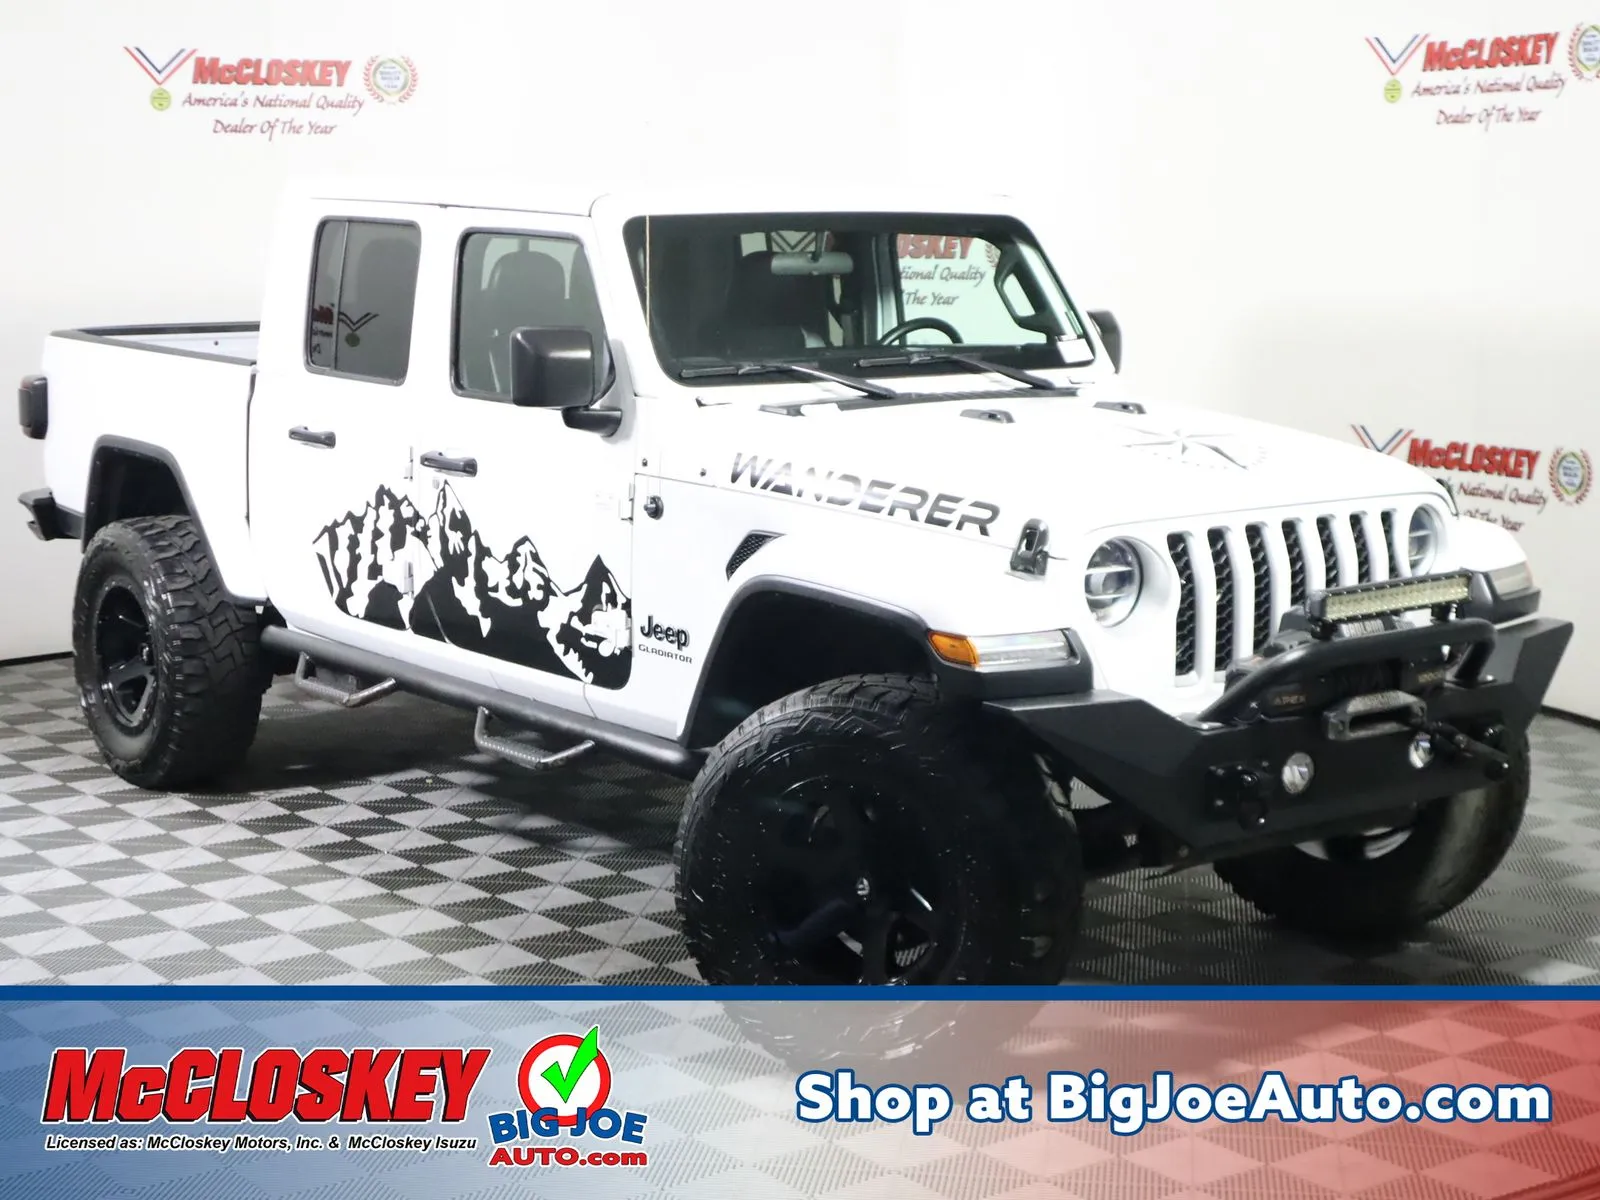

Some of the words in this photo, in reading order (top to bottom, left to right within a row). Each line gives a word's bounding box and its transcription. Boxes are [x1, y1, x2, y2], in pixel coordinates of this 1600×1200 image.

[1421, 32, 1560, 72] McCLOSKEY
[192, 56, 352, 87] McCLOSKEY
[1410, 77, 1470, 97] America's
[1474, 74, 1526, 94] National
[1527, 72, 1567, 98] Quality
[182, 91, 249, 108] America's
[252, 92, 314, 108] National
[315, 95, 364, 116] Quality
[212, 117, 257, 134] Dealer
[259, 118, 280, 142] Of
[280, 118, 303, 134] The
[307, 120, 337, 135] Year
[1436, 106, 1475, 125] Dealer
[1478, 105, 1496, 131] Of
[1495, 105, 1514, 123] The
[1518, 106, 1542, 123] Year
[940, 264, 985, 287] Quality
[905, 289, 927, 305] The
[930, 292, 960, 306] Year
[1407, 437, 1541, 480] McCLOSKEY
[730, 452, 1001, 537] WANDERER
[1457, 482, 1508, 501] National
[1508, 485, 1549, 515] Quality
[1501, 513, 1525, 532] Year
[640, 614, 690, 651] Jeep
[638, 643, 693, 664] GLADIATOR
